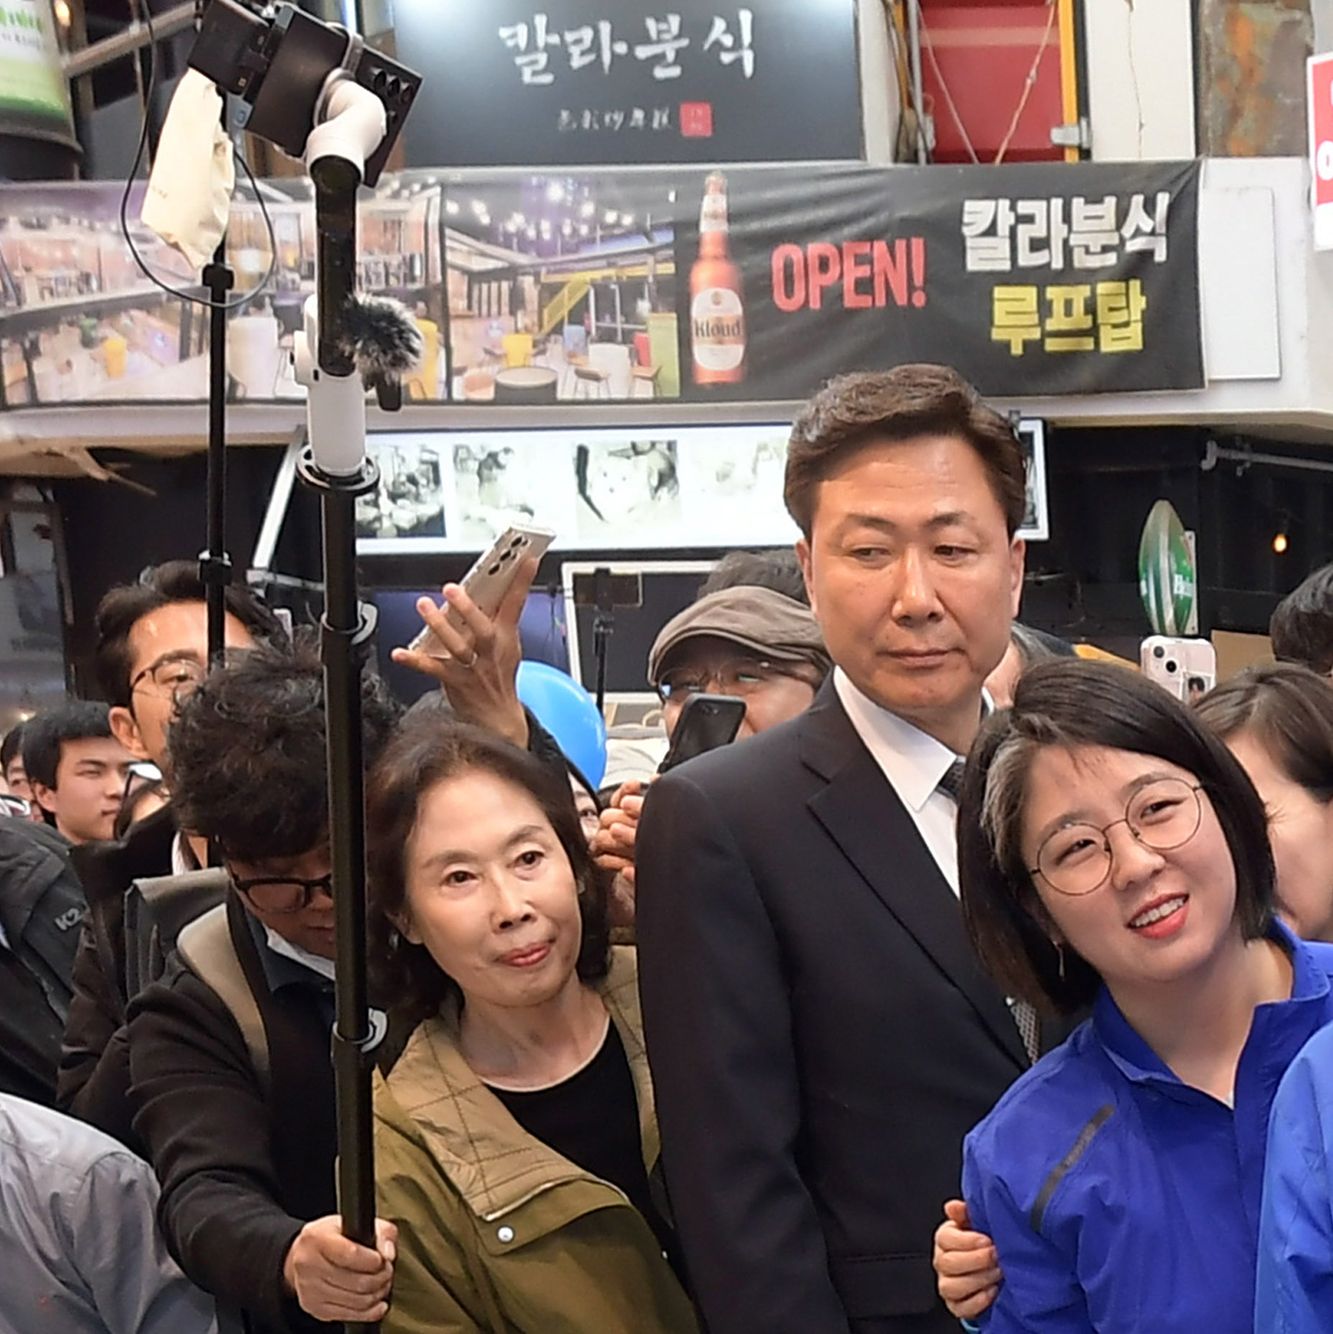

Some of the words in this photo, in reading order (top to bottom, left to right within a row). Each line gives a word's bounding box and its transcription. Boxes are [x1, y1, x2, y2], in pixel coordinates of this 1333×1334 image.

[498, 8, 756, 84] 칼라분식
[961, 191, 1171, 272] 칼라분식
[771, 236, 928, 312] OPEN!
[991, 278, 1147, 357] 루프탑
